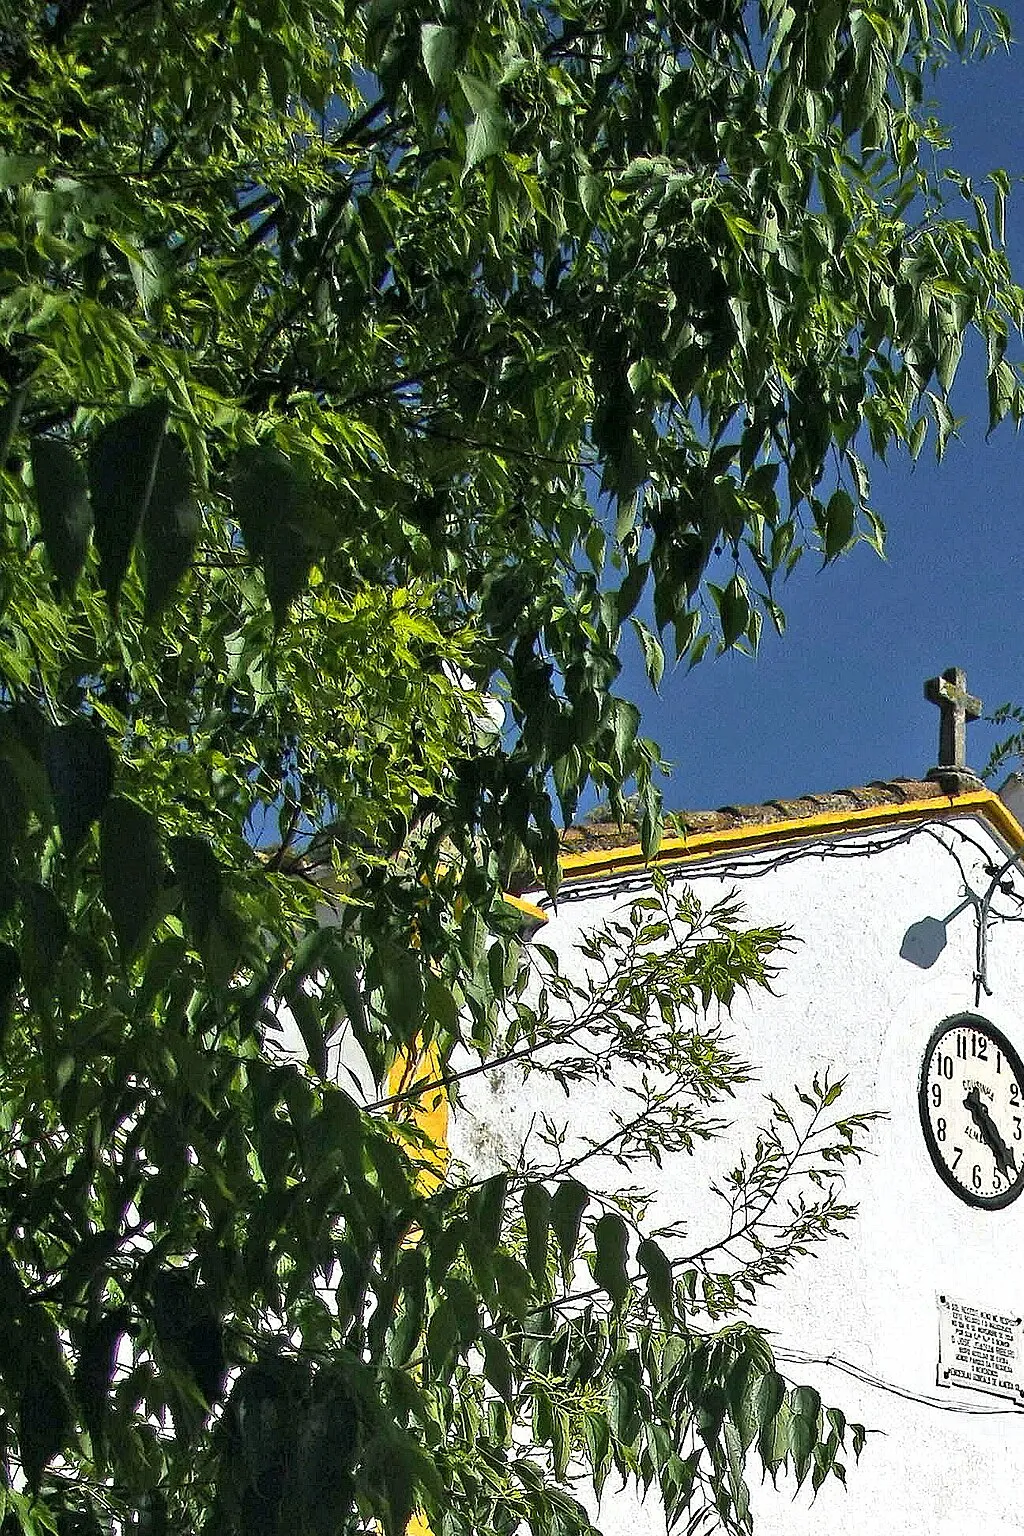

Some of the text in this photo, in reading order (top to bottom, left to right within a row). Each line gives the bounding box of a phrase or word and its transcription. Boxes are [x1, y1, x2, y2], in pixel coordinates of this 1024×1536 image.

[971, 1033, 988, 1061] 12
[937, 1052, 954, 1080] 10
[996, 1051, 1001, 1074] 1
[932, 1083, 942, 1108] 9
[1009, 1083, 1020, 1107] 2
[937, 1117, 947, 1142] 8
[1013, 1116, 1022, 1141] 3
[952, 1147, 963, 1170] 7
[972, 1164, 982, 1189] 6
